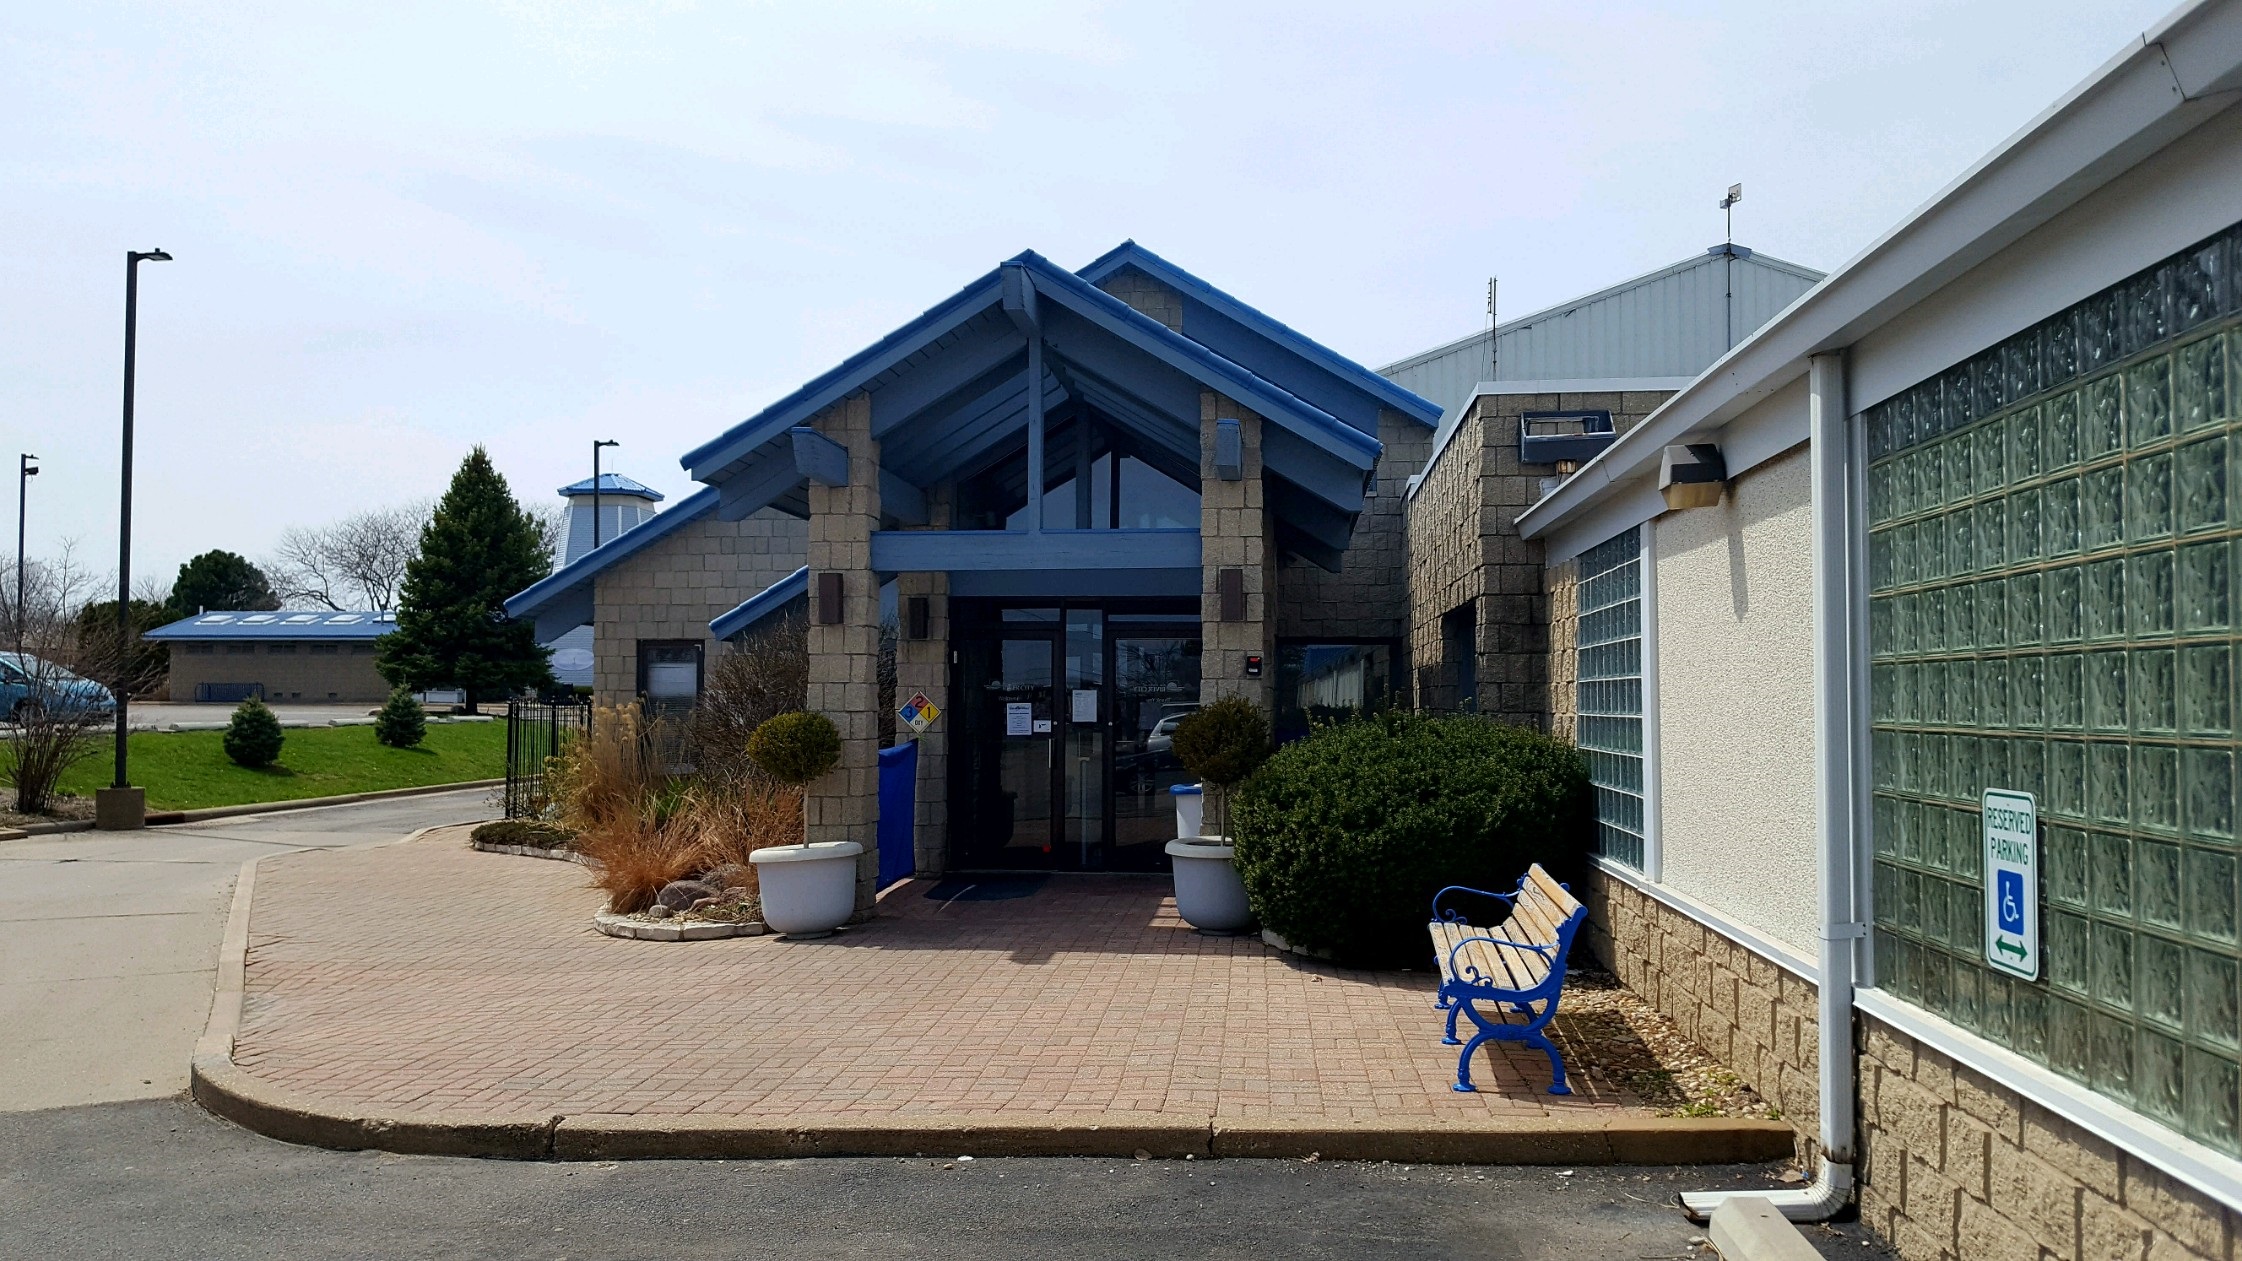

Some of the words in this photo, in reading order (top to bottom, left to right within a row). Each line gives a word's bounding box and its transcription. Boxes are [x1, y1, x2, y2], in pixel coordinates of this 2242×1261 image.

[915, 695, 924, 708] 2
[905, 706, 913, 719] 3
[927, 706, 931, 719] 1
[1987, 807, 2031, 834] RESERVED
[1991, 837, 2028, 865] PARKING
